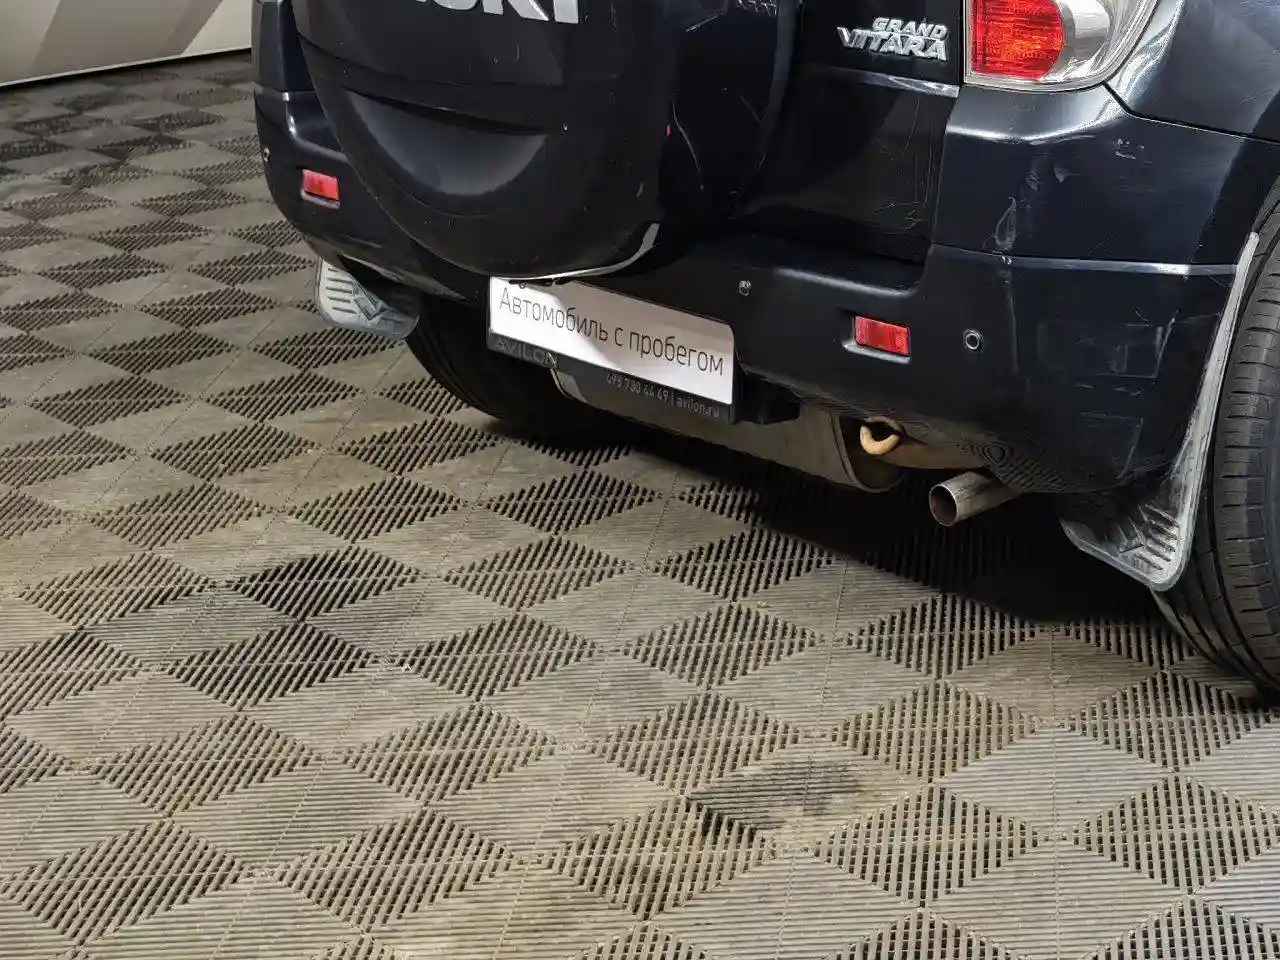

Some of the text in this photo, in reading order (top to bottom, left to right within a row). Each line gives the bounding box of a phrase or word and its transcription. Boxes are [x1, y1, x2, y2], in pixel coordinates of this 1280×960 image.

[836, 26, 947, 61] VITARA
[872, 16, 948, 40] GRAND
[499, 286, 723, 376] Автомобиль с пробегом
[496, 339, 558, 366] AVILON
[624, 378, 641, 395] 730
[677, 395, 720, 419] avilon.ru
